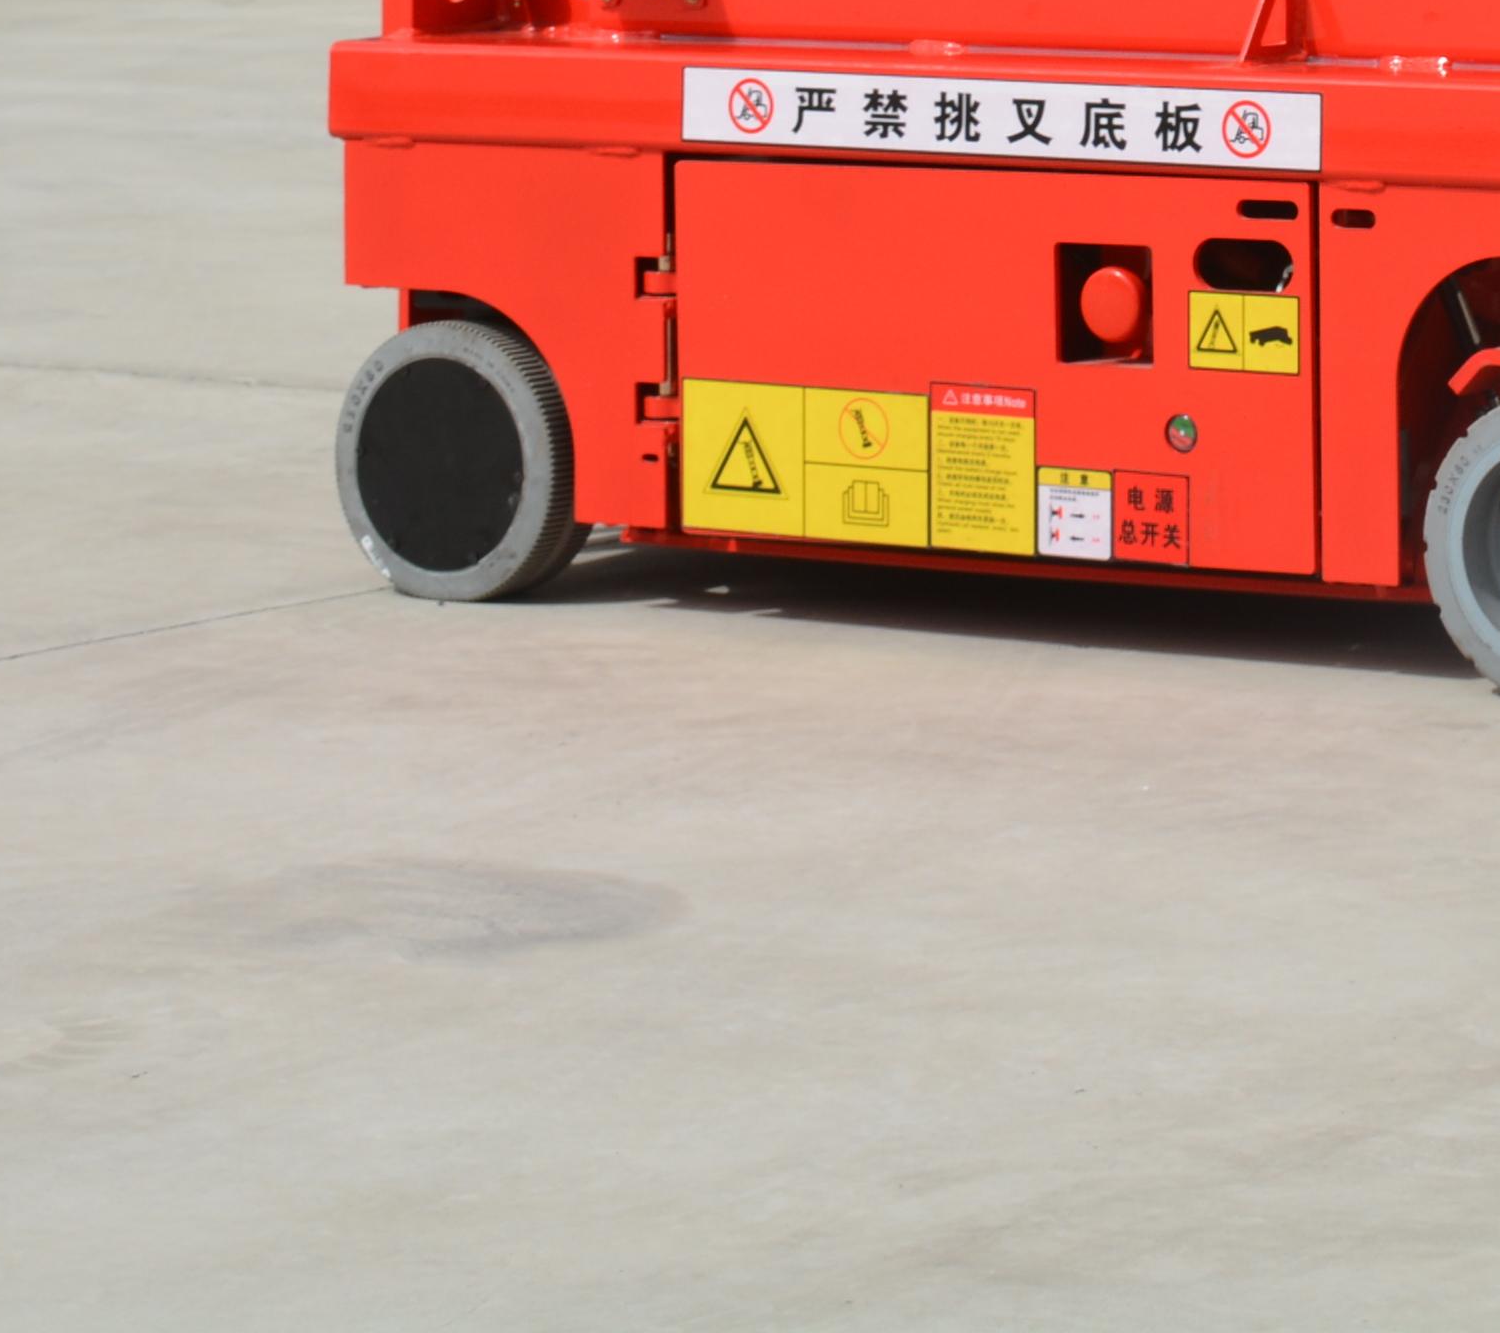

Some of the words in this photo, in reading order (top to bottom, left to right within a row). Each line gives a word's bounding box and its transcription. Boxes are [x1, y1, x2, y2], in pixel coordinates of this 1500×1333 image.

[792, 86, 1203, 153] 严禁挑叉底板
[1127, 486, 1174, 513] 电源
[1119, 520, 1181, 549] 总开关
